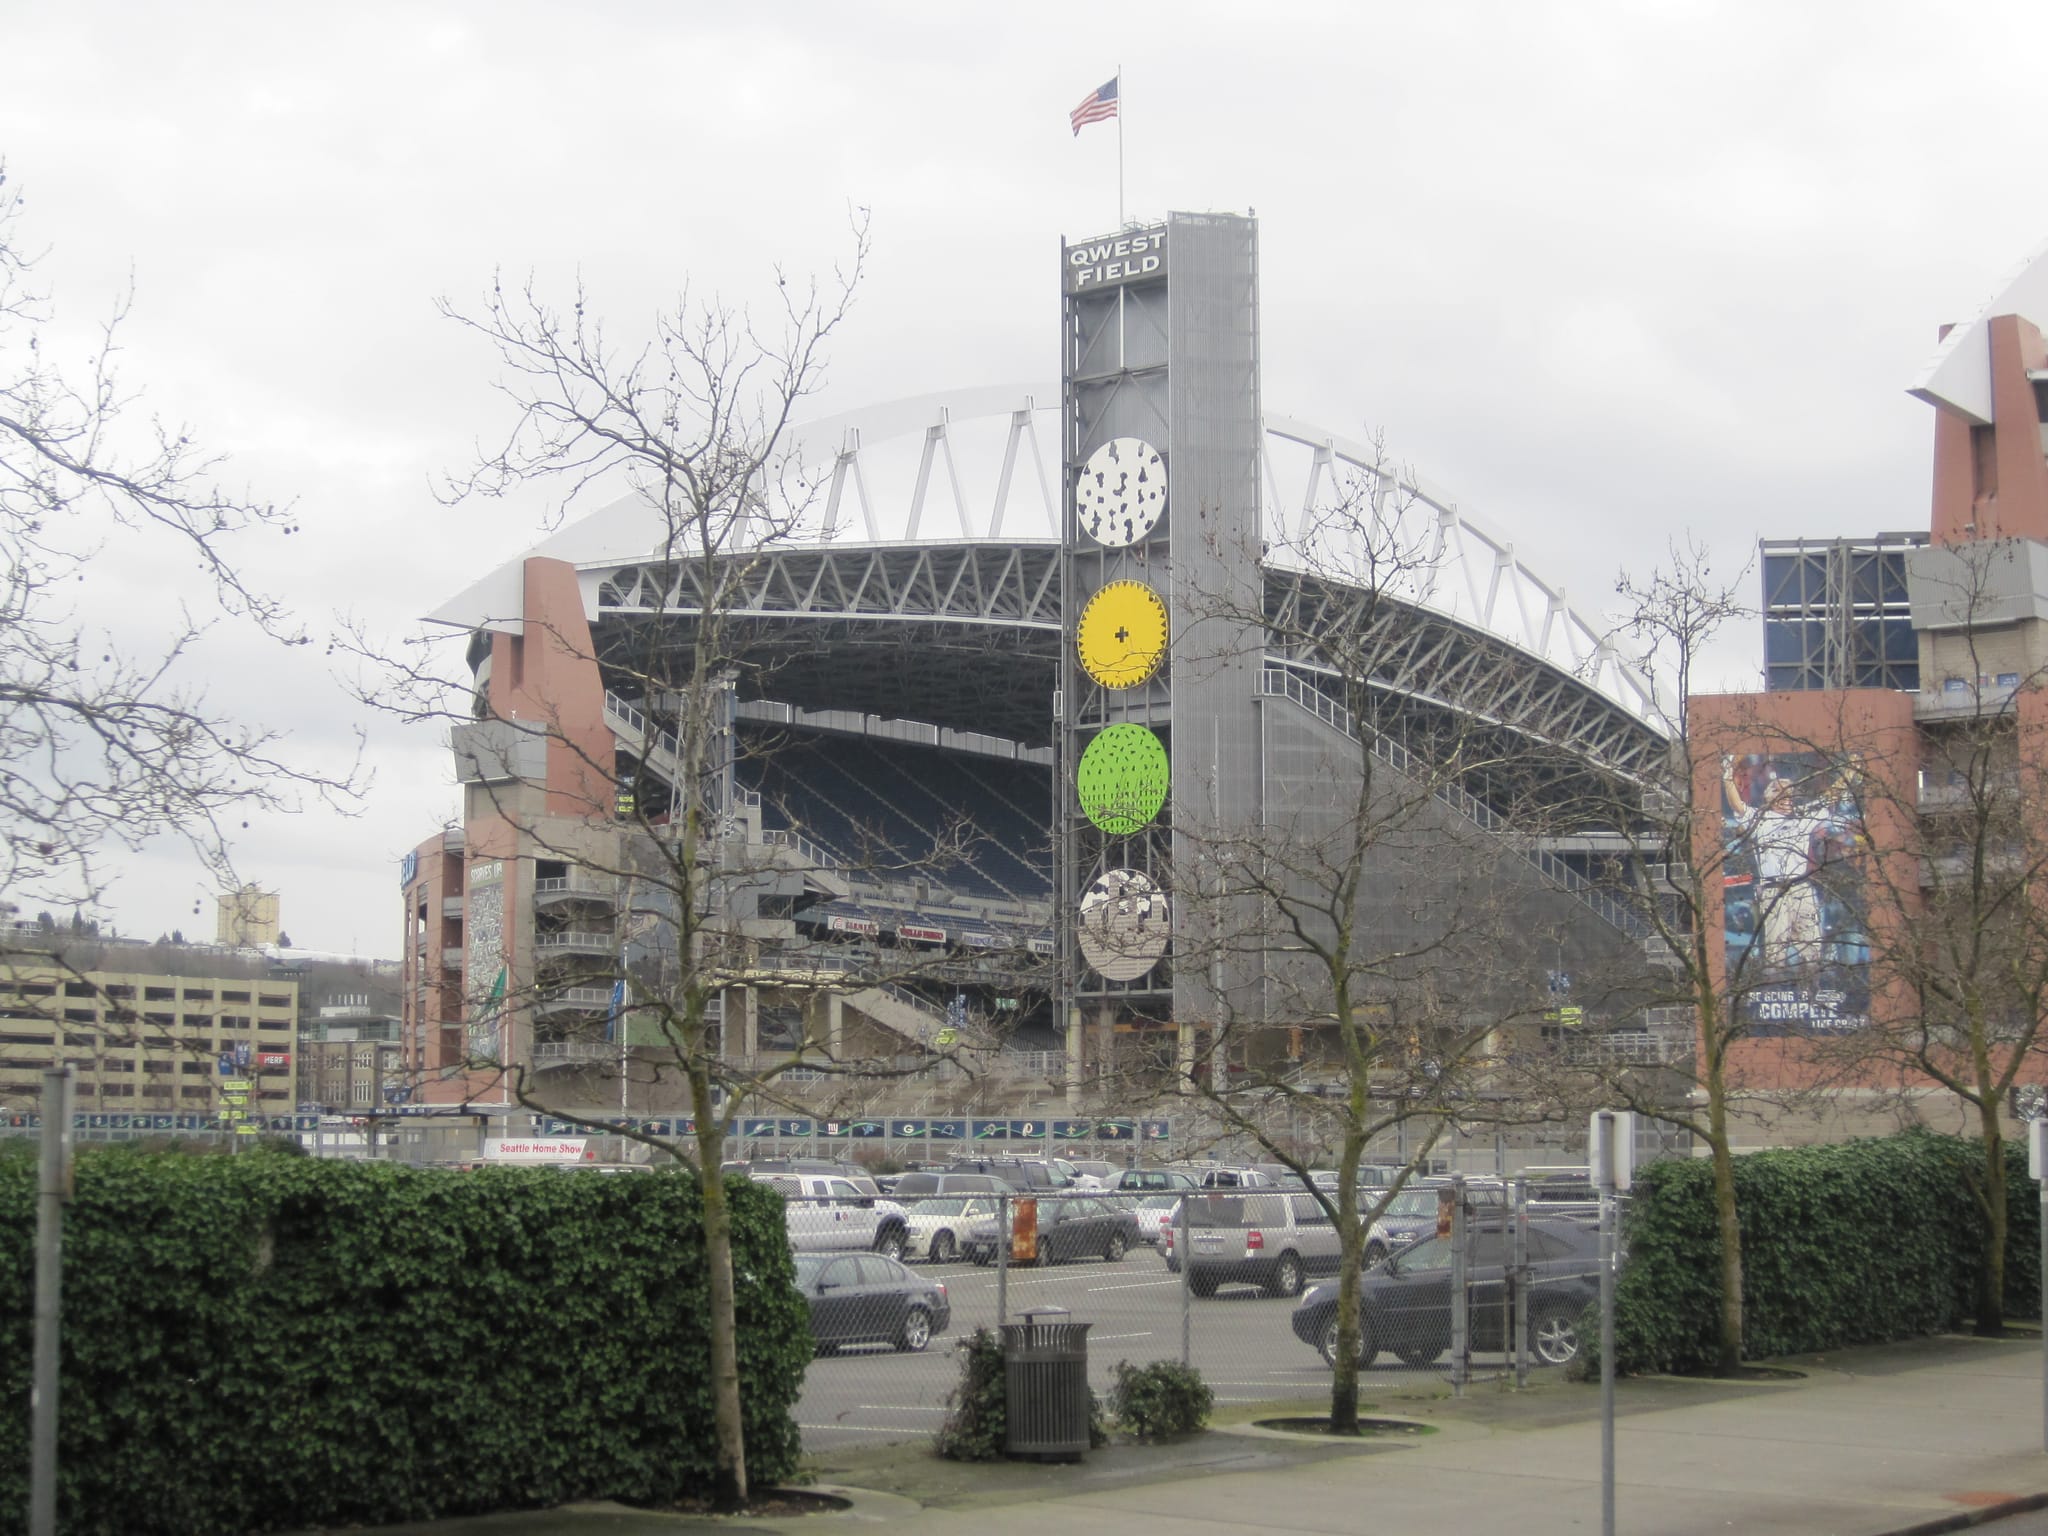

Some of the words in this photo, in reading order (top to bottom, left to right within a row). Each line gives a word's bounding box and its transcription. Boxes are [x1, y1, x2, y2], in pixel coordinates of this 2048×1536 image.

[1070, 232, 1166, 266] QWEST
[1078, 255, 1160, 286] FIELD
[500, 1143, 530, 1153] Seattle
[532, 1143, 557, 1153] Home
[559, 1143, 582, 1153] Show
